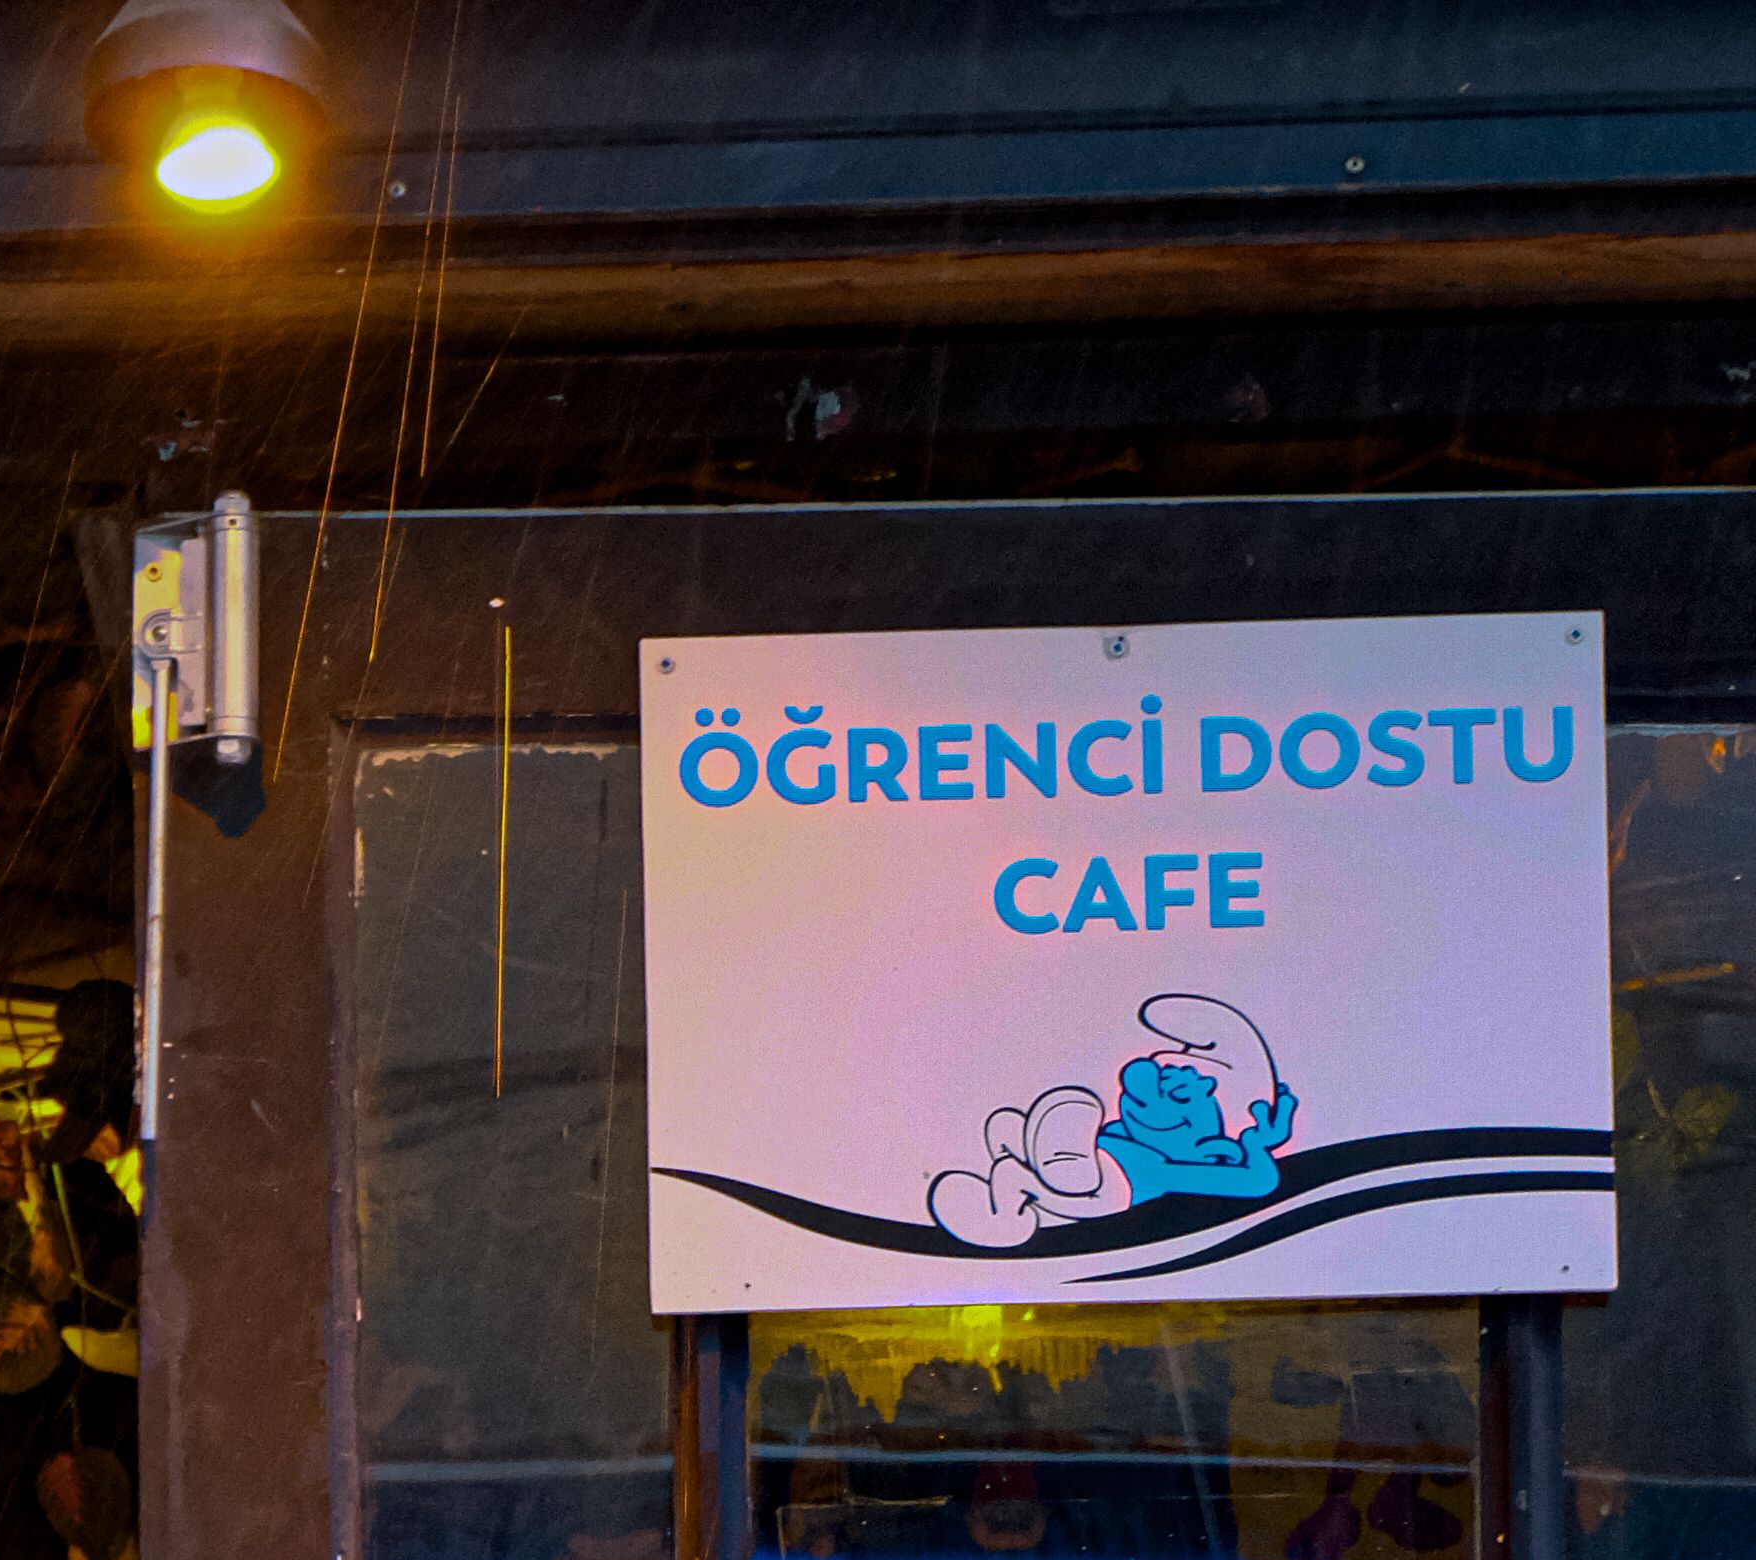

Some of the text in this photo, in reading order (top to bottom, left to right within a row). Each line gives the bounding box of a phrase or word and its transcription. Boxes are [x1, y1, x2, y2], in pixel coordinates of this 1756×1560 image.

[679, 694, 1576, 807] ÖĞRENCİ DOSTU
[993, 851, 1266, 935] CAFE
